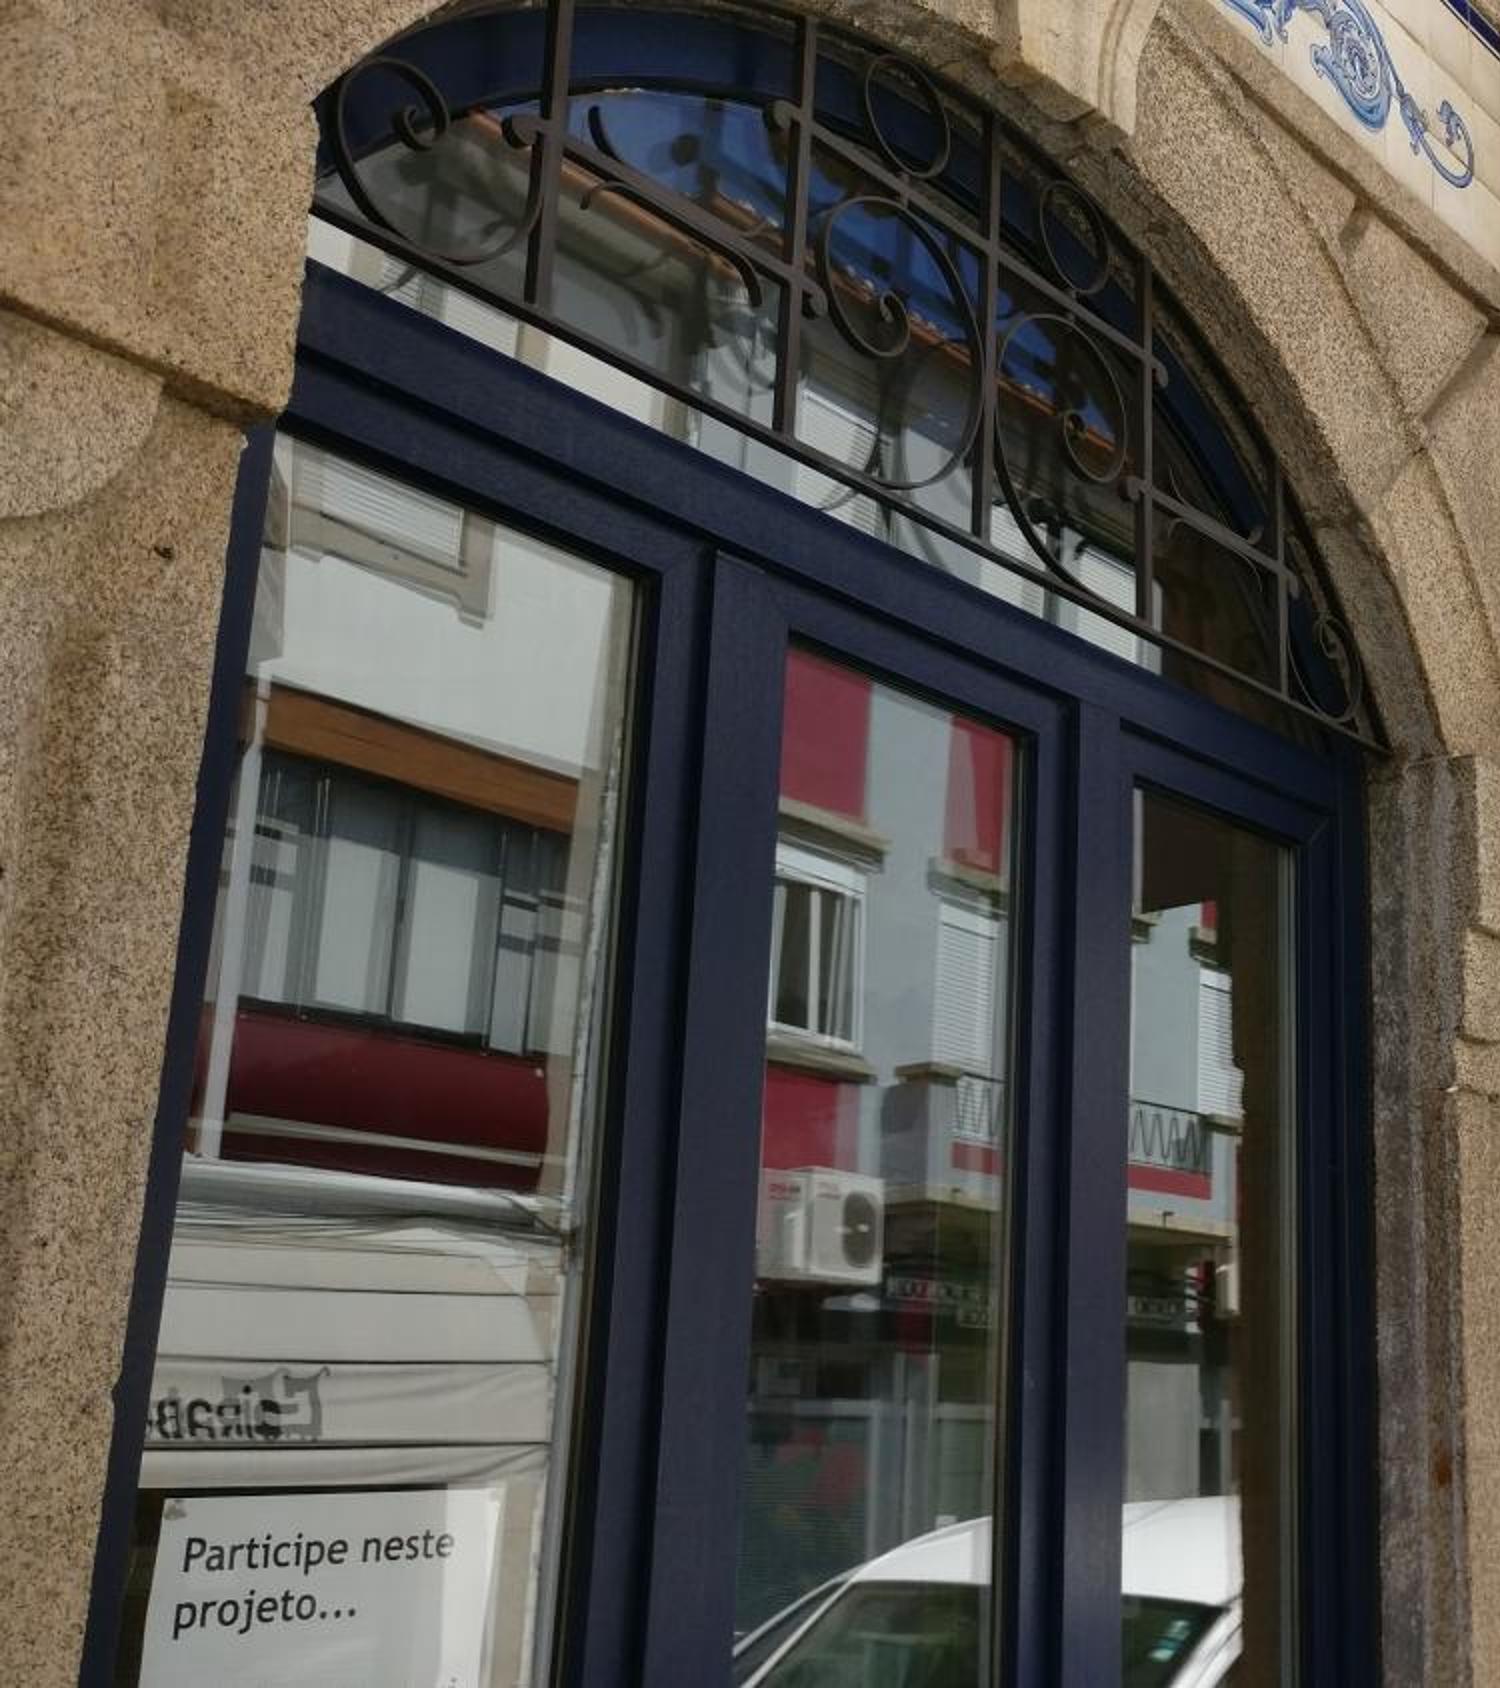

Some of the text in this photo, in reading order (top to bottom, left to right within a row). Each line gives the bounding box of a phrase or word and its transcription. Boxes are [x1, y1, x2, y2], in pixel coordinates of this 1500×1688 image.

[182, 1528, 455, 1575] Participe neste
[172, 1590, 357, 1640] projeto...
